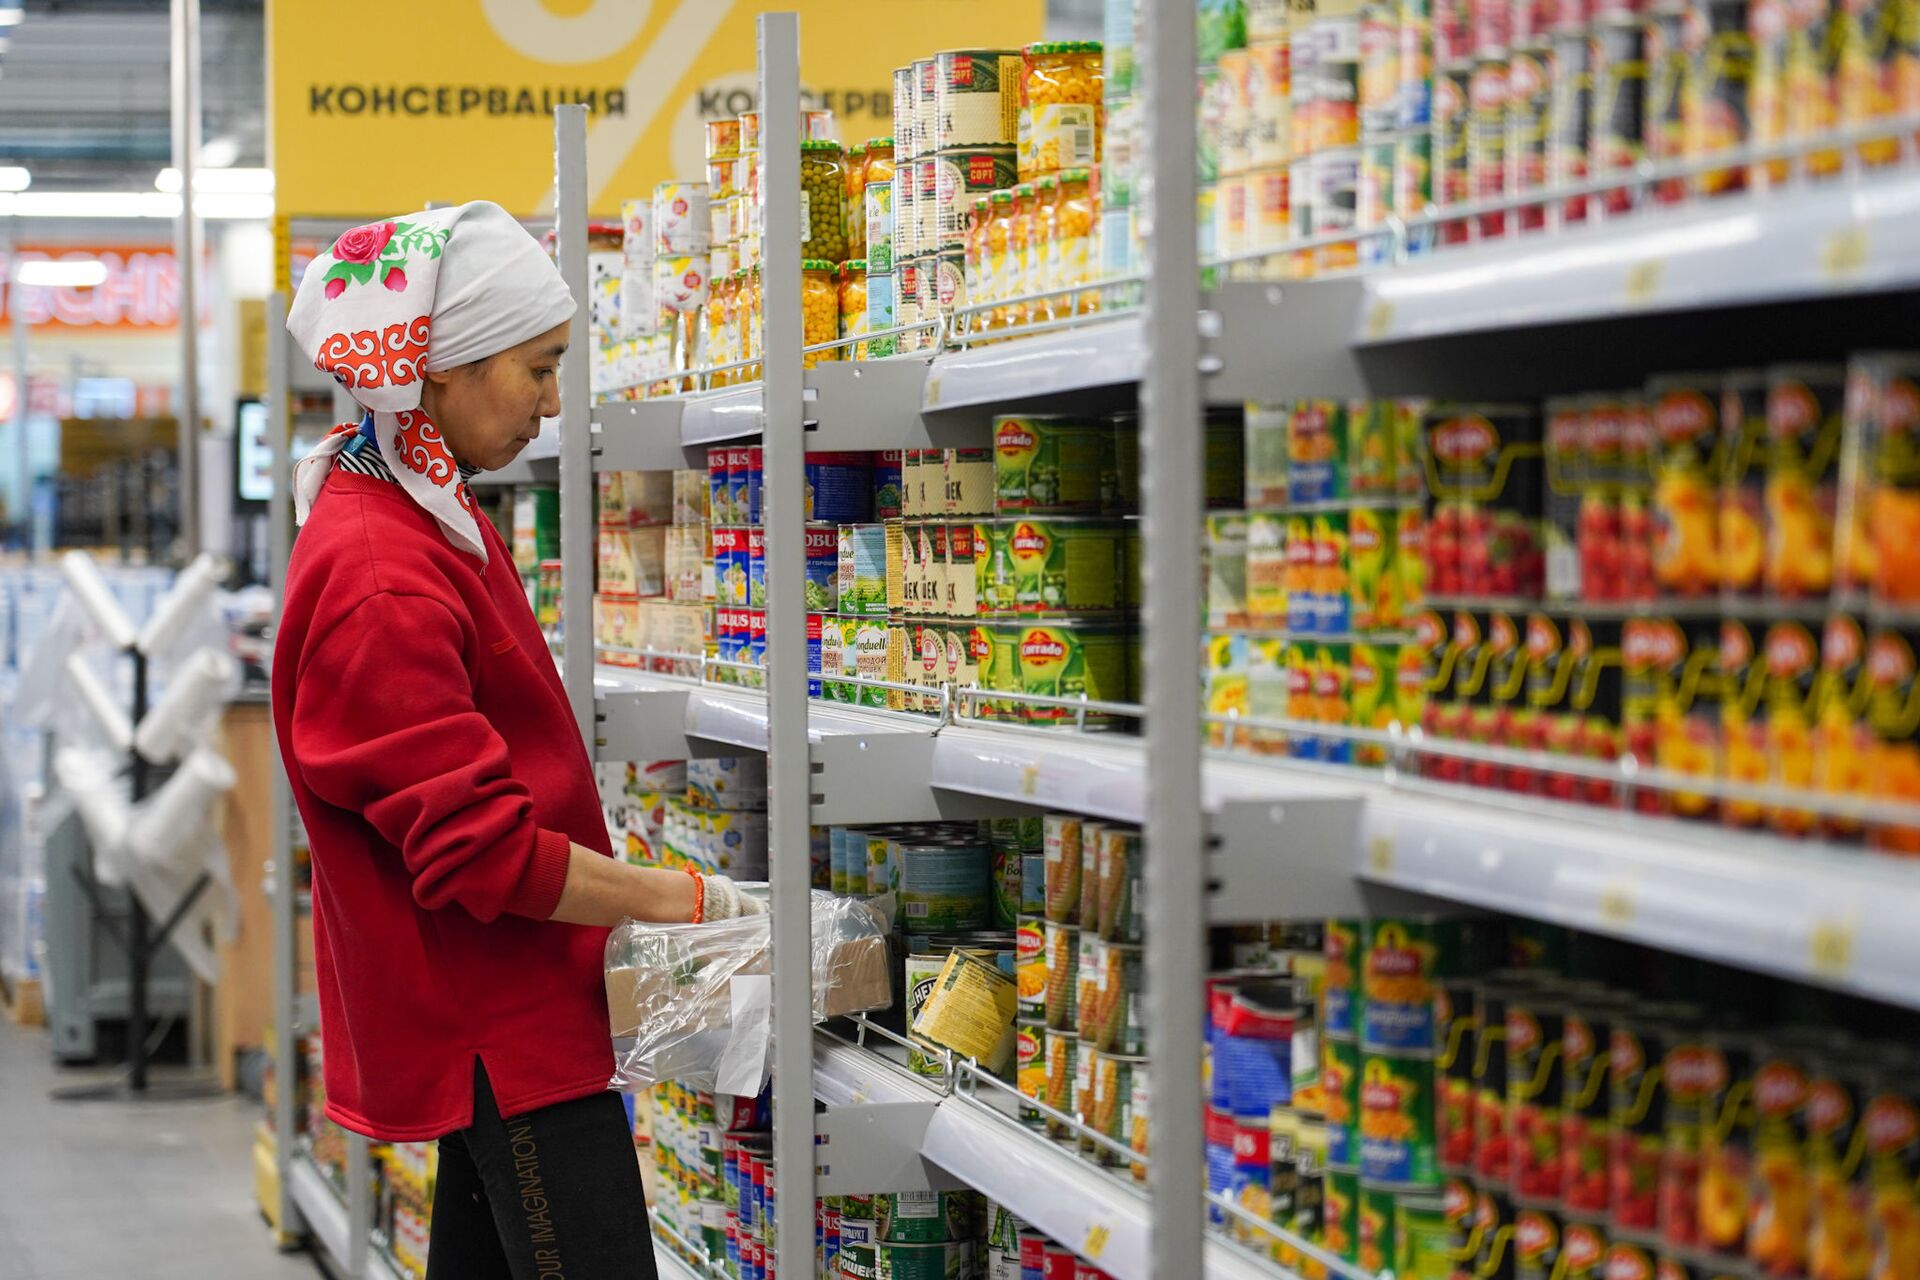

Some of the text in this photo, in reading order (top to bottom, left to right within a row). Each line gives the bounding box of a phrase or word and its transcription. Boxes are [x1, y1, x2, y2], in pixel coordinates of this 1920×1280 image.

[309, 85, 626, 116] КОНСЕРВАЦИЯ
[970, 169, 993, 180] СОРТ
[509, 1125, 556, 1242] IMAGINATION
